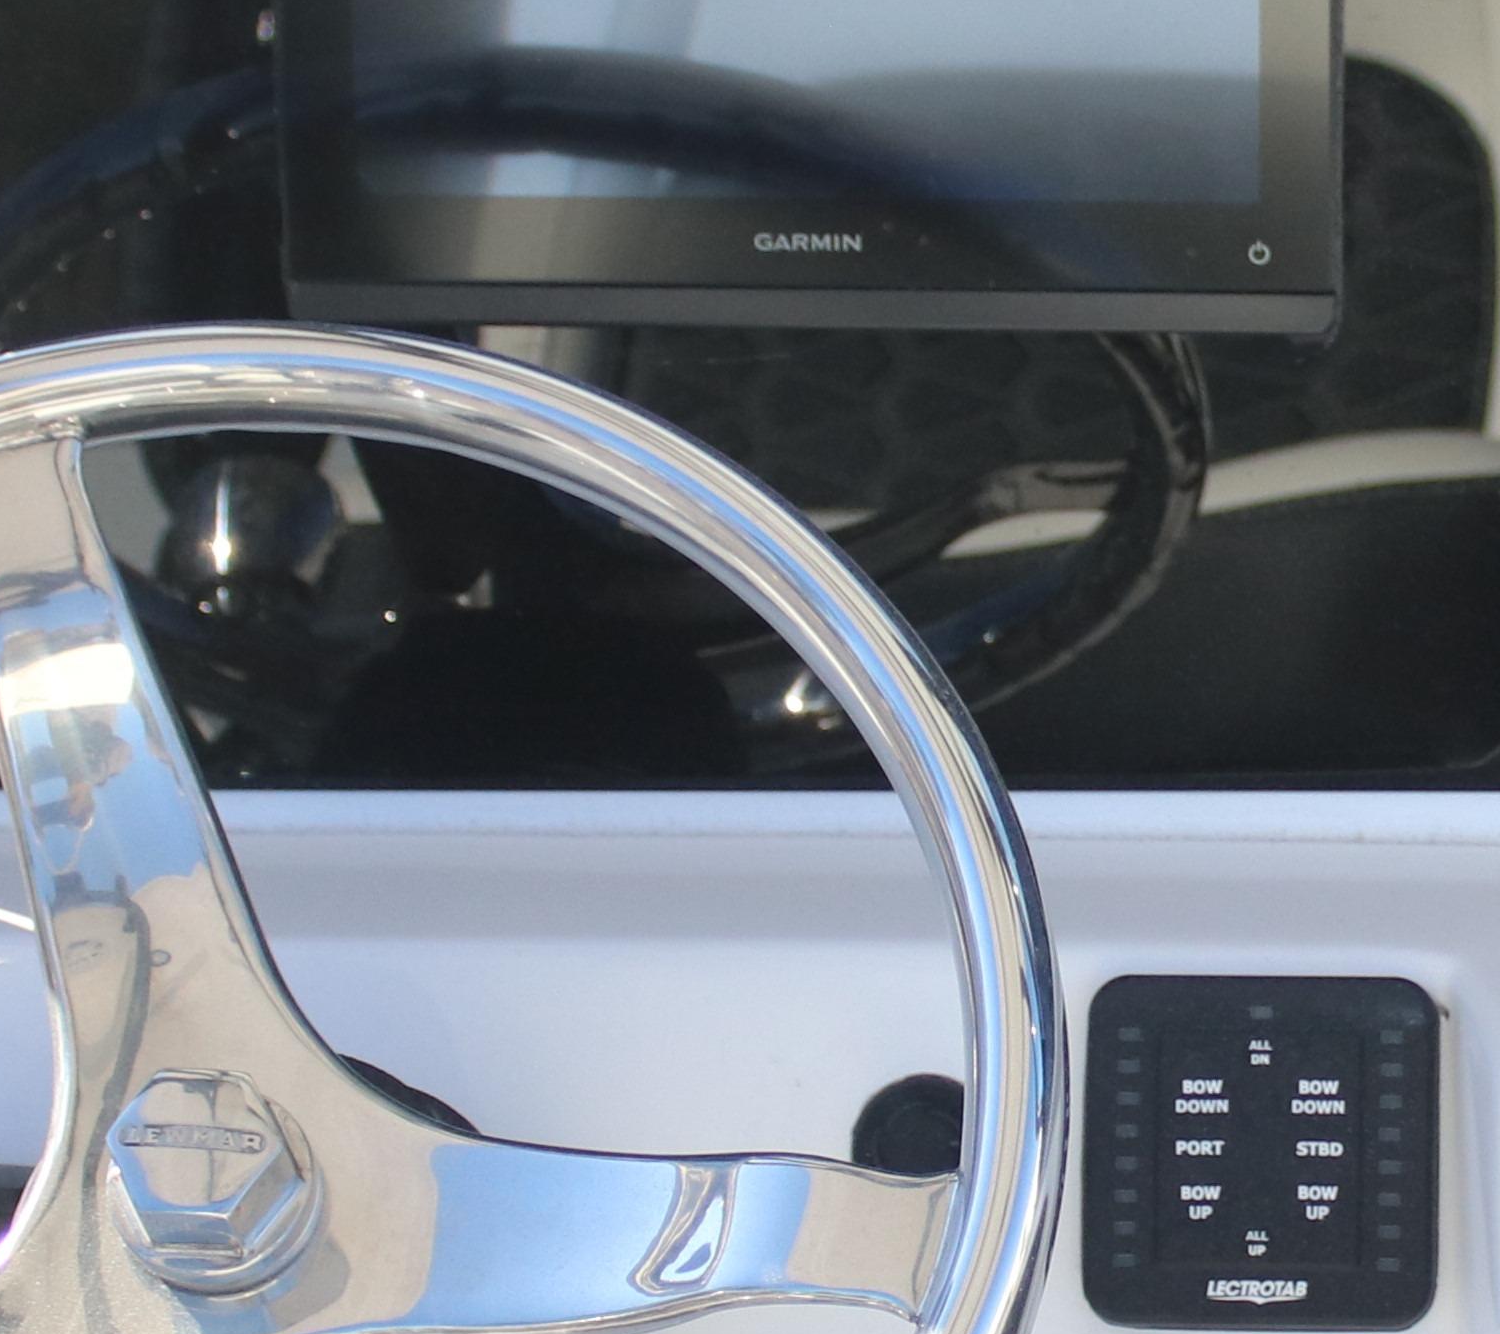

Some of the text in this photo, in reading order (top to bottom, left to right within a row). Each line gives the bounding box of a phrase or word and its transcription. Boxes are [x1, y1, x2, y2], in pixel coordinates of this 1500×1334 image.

[754, 233, 862, 252] GARMIN
[1249, 1040, 1272, 1051] ALL
[1251, 1054, 1270, 1065] DN
[1182, 1080, 1223, 1094] BOW
[1299, 1080, 1339, 1094] BOW
[1175, 1100, 1229, 1114] DOWN
[1291, 1100, 1345, 1114] DOWN
[126, 1126, 263, 1151] LEWMAR
[1175, 1140, 1225, 1155] PORT
[1296, 1141, 1343, 1156] STBD
[1180, 1186, 1221, 1200] BOW
[1297, 1186, 1338, 1200] BOW
[1189, 1206, 1212, 1220] UP
[1306, 1206, 1329, 1220] UP
[1245, 1230, 1269, 1241] ALL
[1248, 1244, 1266, 1256] UP
[1206, 1280, 1307, 1297] LECTROTAB
